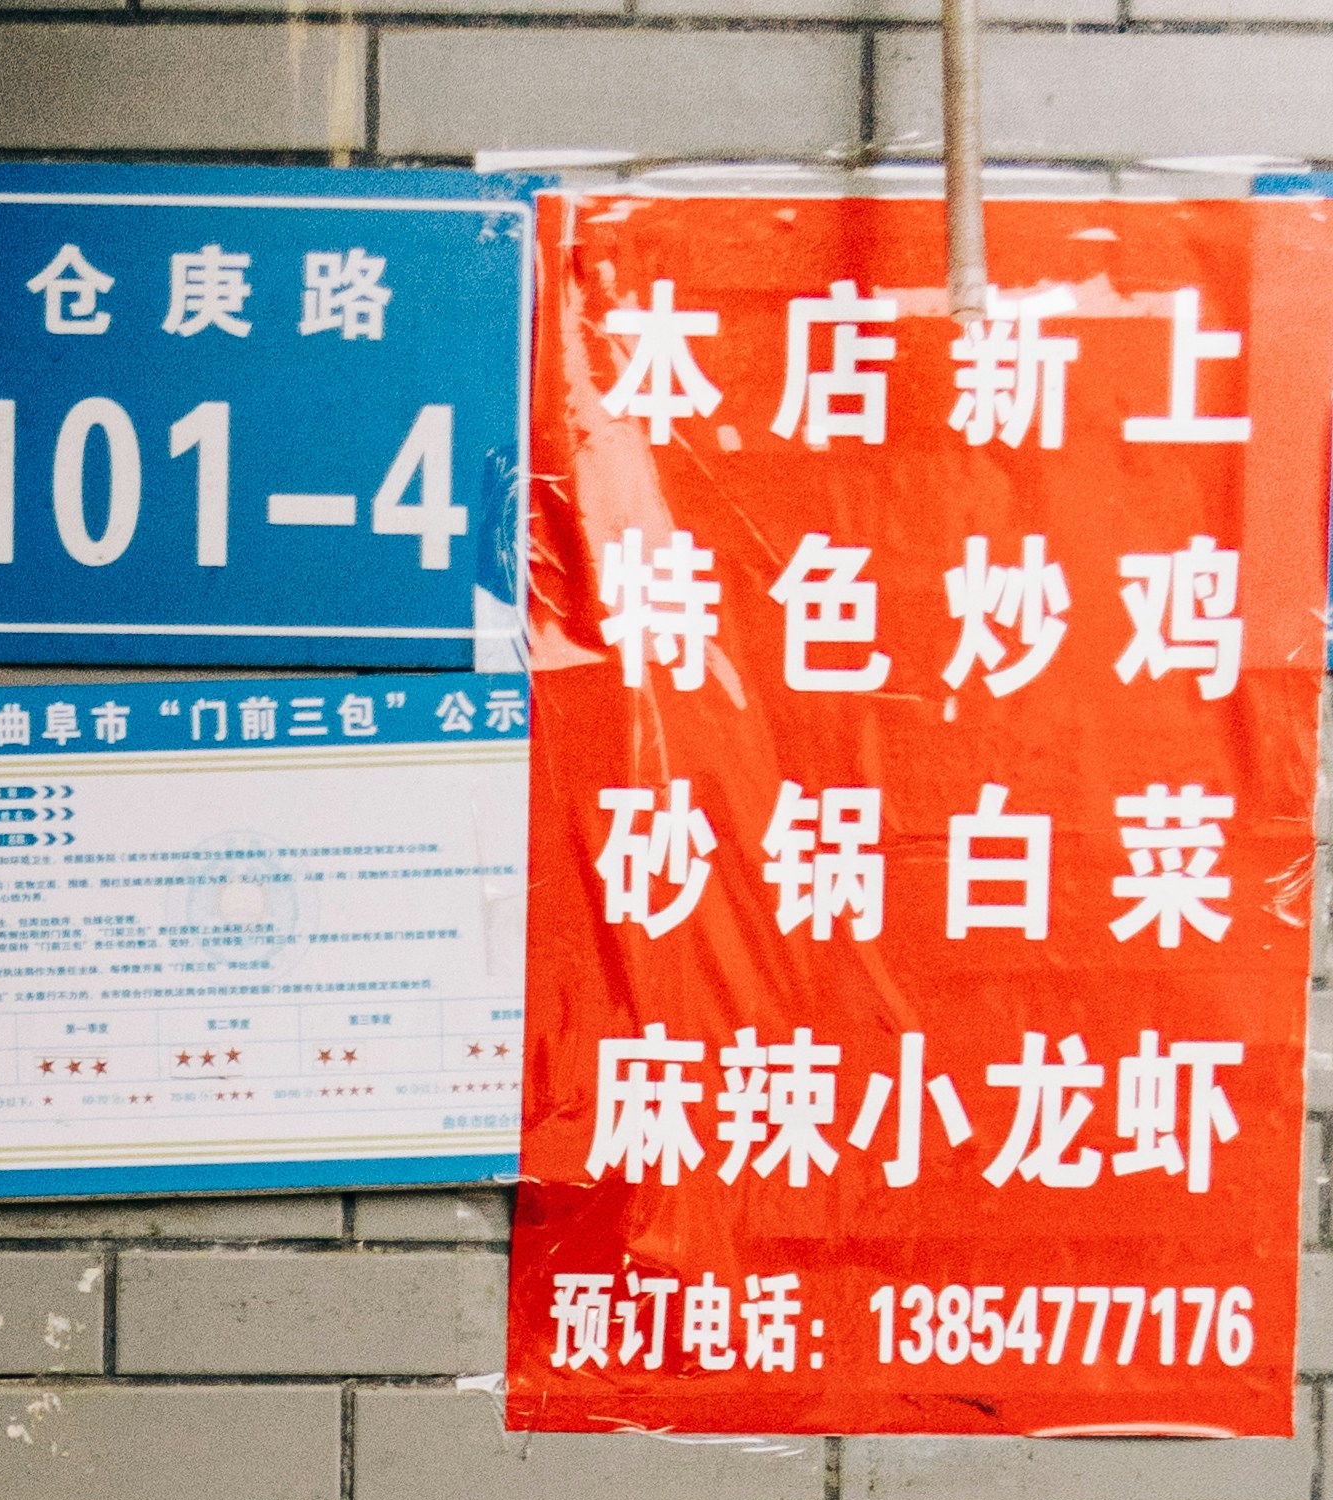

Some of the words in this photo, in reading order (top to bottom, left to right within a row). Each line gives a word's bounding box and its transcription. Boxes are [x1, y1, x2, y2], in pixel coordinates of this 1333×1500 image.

[27, 244, 393, 341] 仓庚路
[599, 279, 1253, 449] 本店新上
[597, 528, 1245, 701] 特色炒鸡
[595, 779, 1236, 949] 砂锅白菜
[585, 1023, 1245, 1193] 麻辣小龙虾
[870, 1285, 1253, 1367] 13854777176
